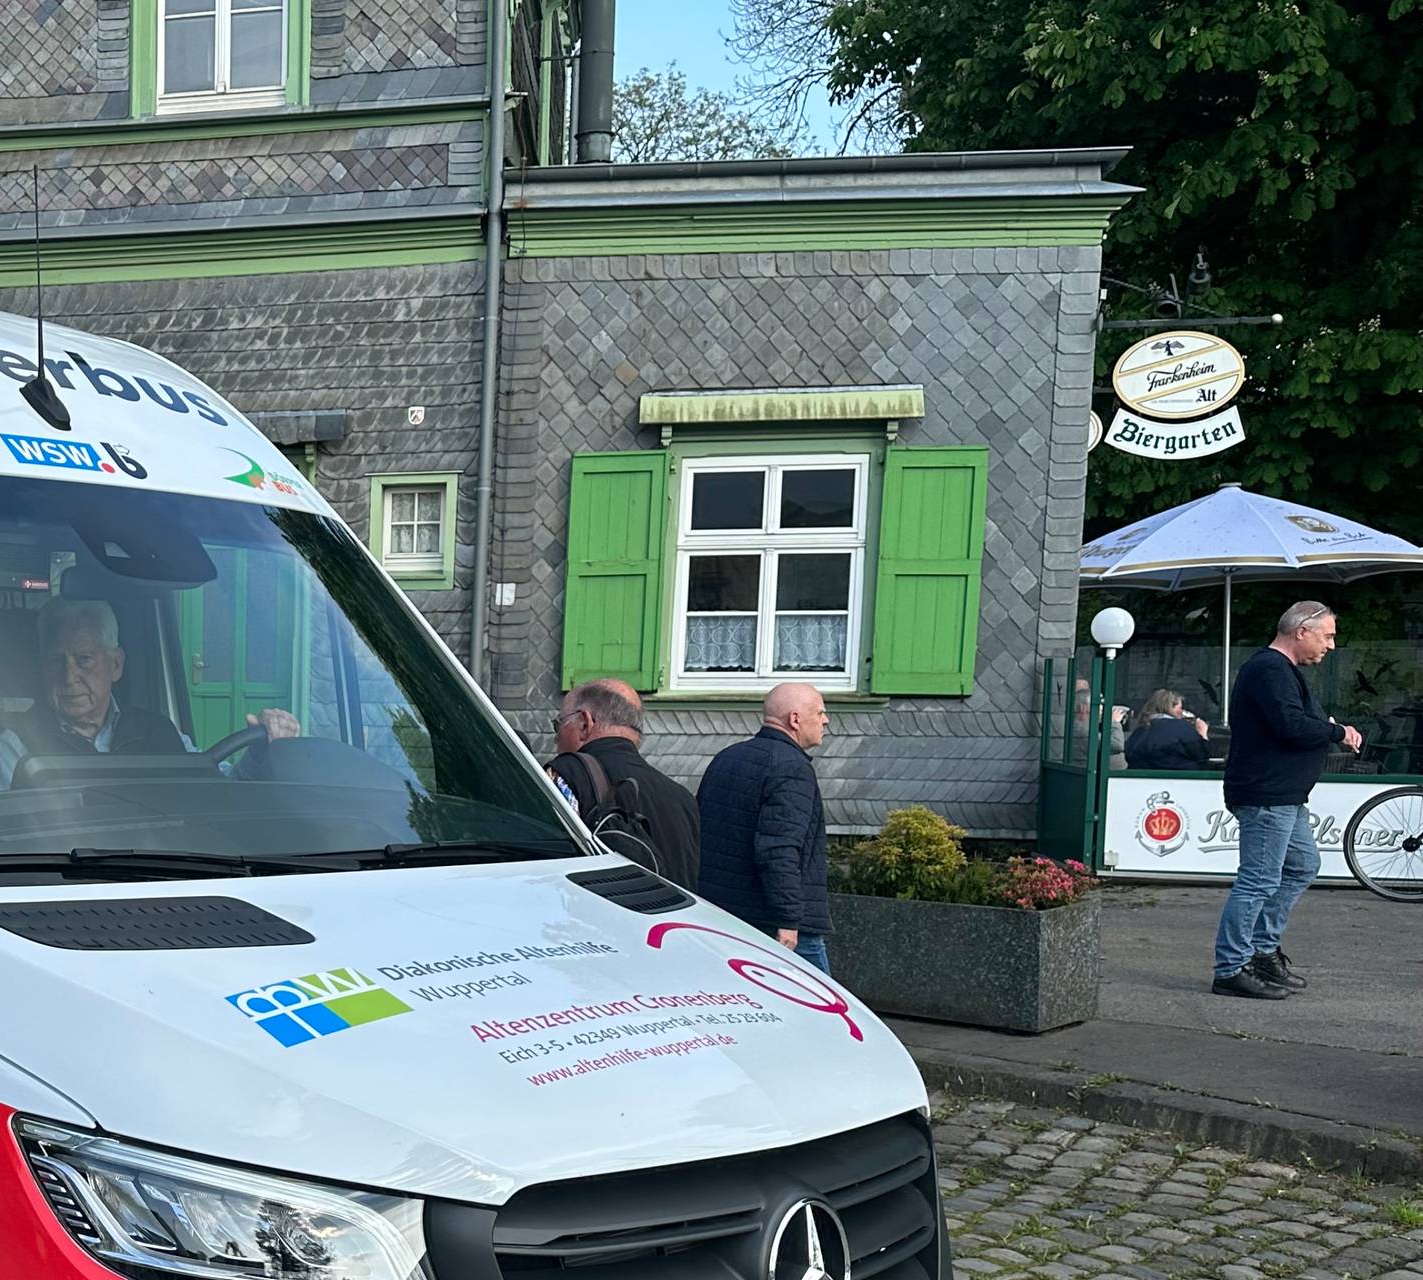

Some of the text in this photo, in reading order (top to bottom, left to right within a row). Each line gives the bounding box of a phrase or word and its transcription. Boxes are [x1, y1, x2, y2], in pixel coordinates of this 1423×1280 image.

[1146, 361, 1216, 392] Frankenheim
[1196, 388, 1217, 402] Alt
[7, 437, 94, 467] WSW
[1113, 418, 1237, 454] Biergarten
[377, 941, 620, 981] Diakonische Altenhilfe
[409, 970, 533, 1002] Wuppertal
[471, 990, 763, 1042] Altenzentrum Cronenberg
[499, 1046, 539, 1064] Eich
[534, 1040, 565, 1055] 3-5
[573, 1026, 621, 1046] 42349
[617, 1015, 696, 1036] Wuppertal
[697, 1014, 726, 1025] Tel.
[527, 1034, 738, 1087] www.altenhilfe-wuppertal.de
